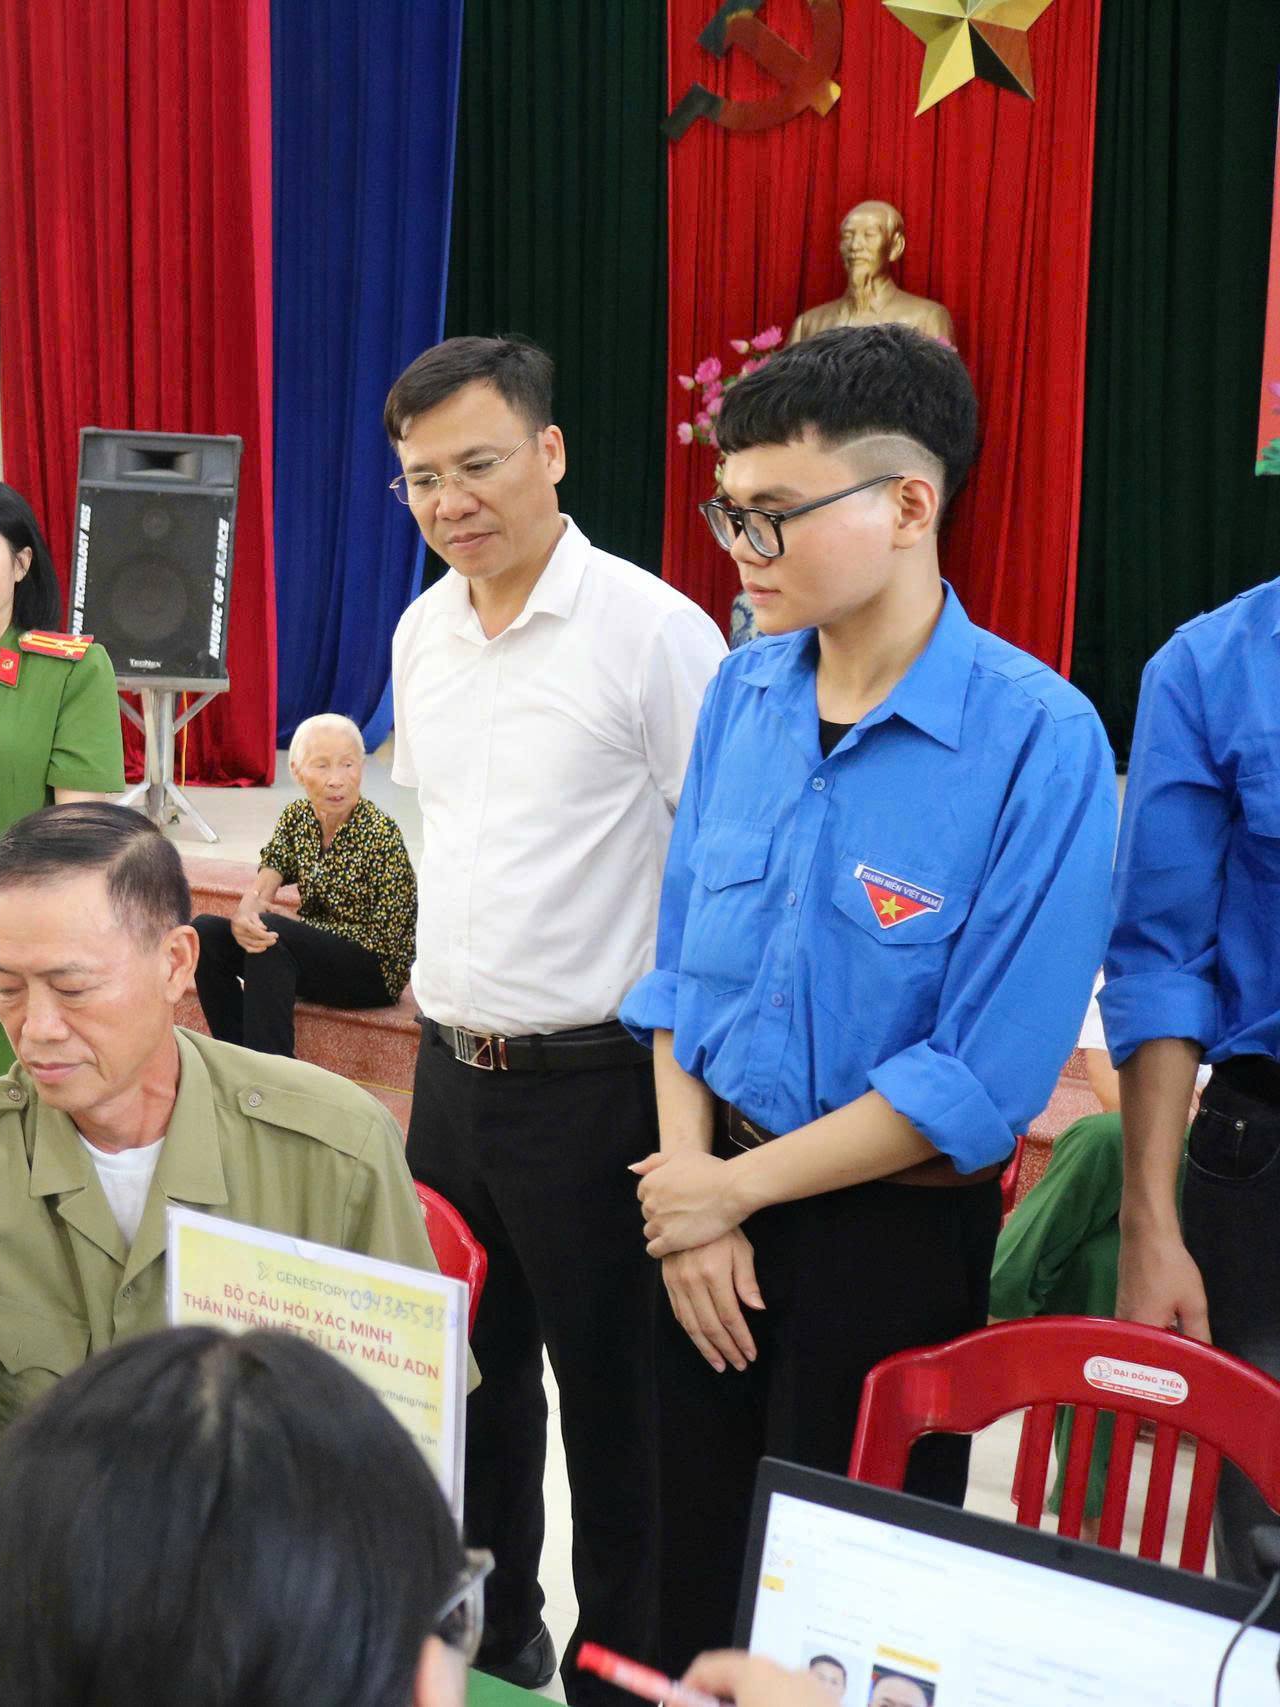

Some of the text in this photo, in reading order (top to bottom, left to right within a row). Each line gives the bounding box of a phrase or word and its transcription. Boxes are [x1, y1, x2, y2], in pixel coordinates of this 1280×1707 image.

[209, 517, 229, 660] MUSIC OF DANCE
[862, 871, 939, 907] THANH NIÊN VIỆT NAM
[276, 1271, 349, 1300] GENESTORY
[183, 1292, 223, 1316] THÂN
[403, 1358, 439, 1380] ADN
[224, 1283, 392, 1345] BỘ CÂU HỎI XÁC MINH
[1131, 1371, 1157, 1383] ĐỒNG
